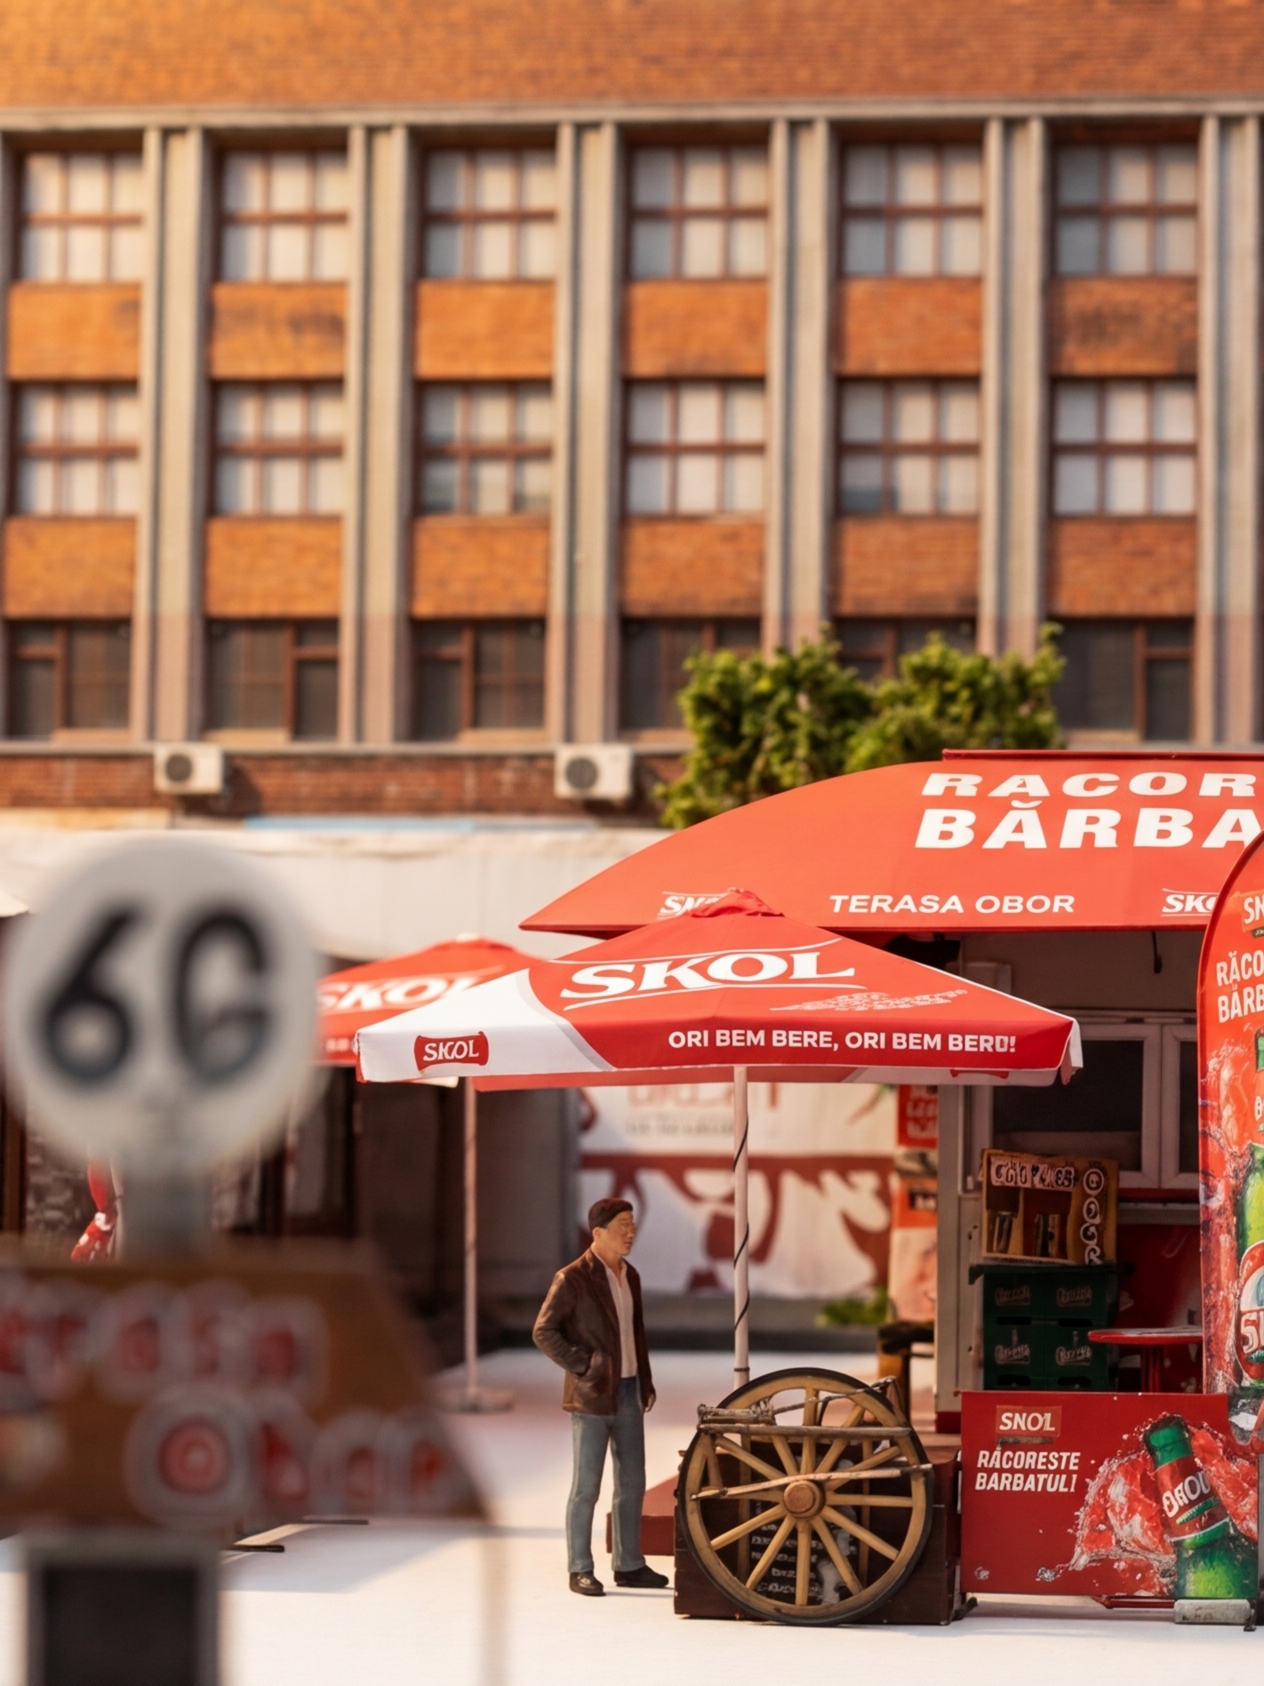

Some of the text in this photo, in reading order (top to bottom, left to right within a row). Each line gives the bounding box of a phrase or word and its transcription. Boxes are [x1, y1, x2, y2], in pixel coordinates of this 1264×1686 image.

[829, 894, 1075, 913] TERASA OBOR
[560, 951, 855, 998] SKOL
[422, 1040, 480, 1062] SKOL
[668, 1031, 709, 1048] ORI
[715, 1030, 766, 1047] BEM
[771, 1030, 839, 1051] BERE,
[845, 1031, 886, 1049] ORI
[892, 1032, 942, 1051] BEM
